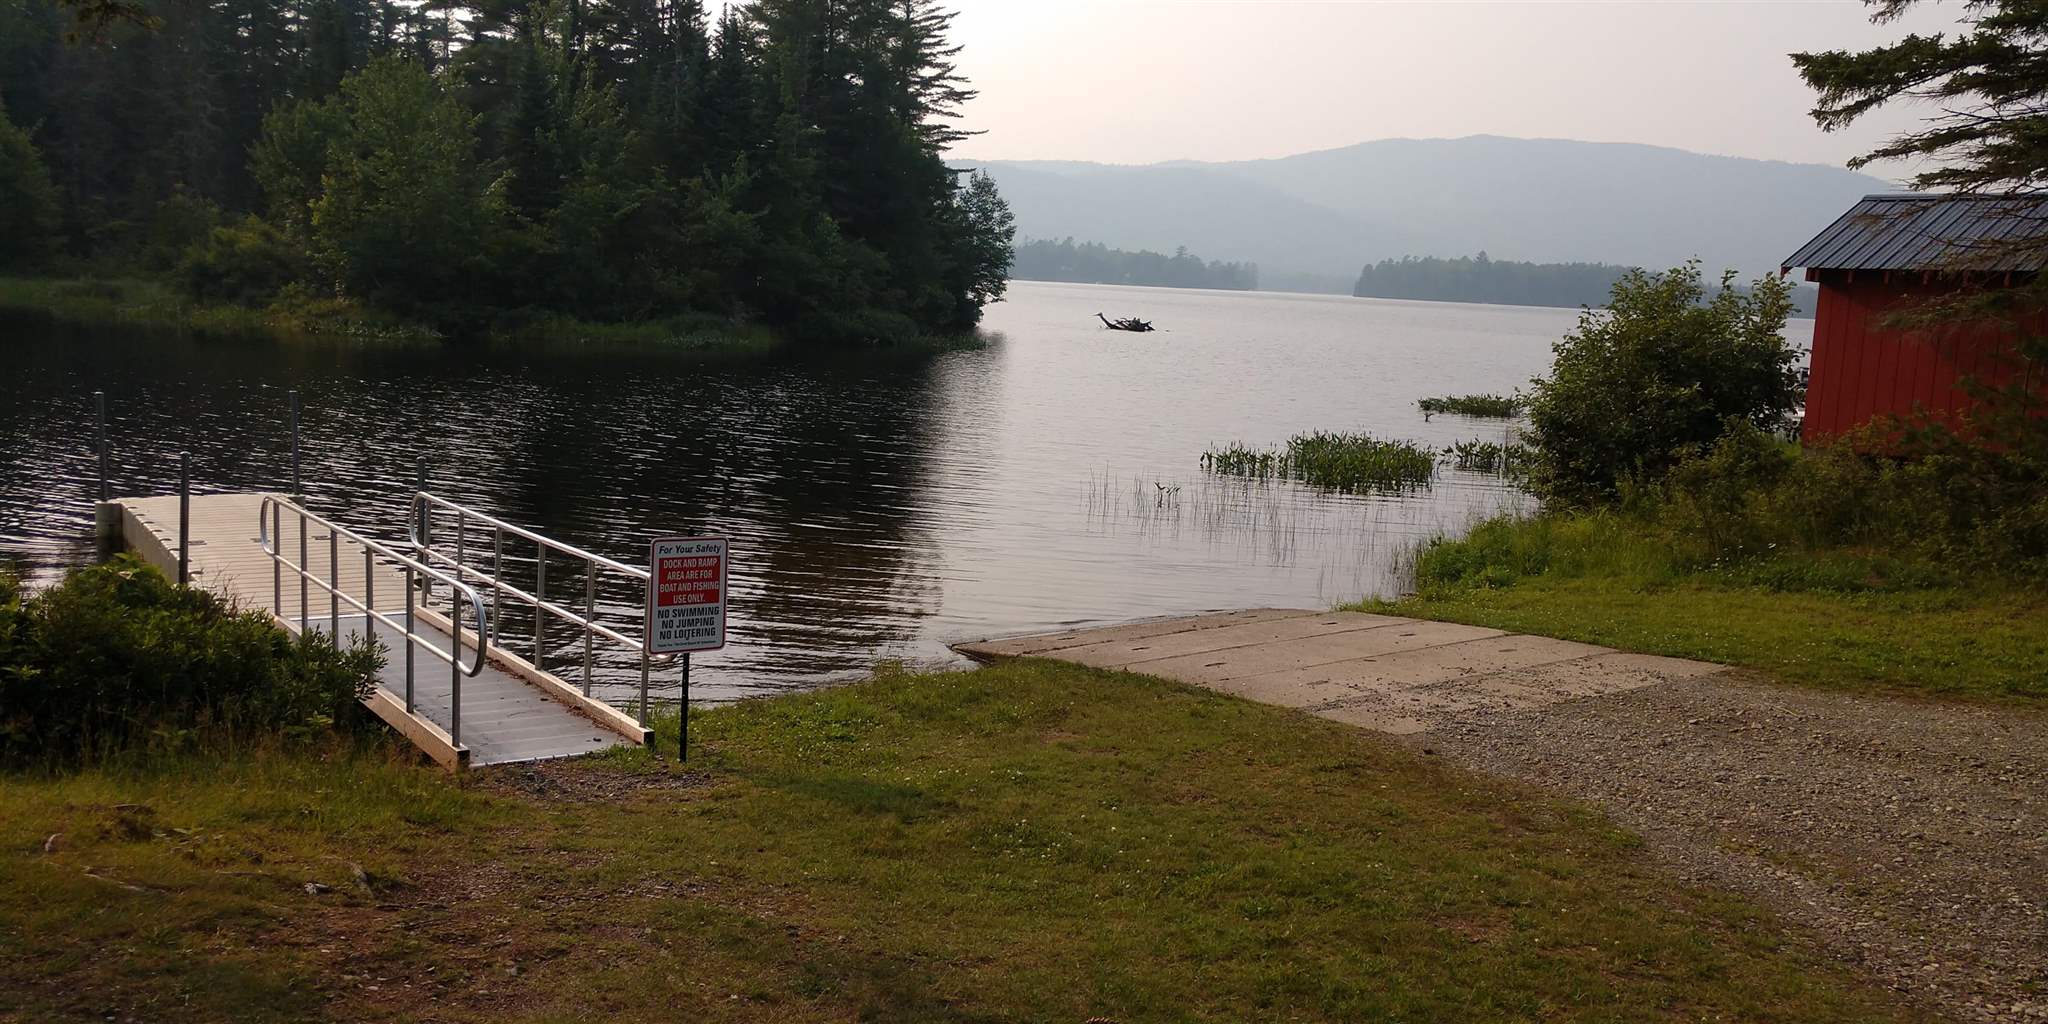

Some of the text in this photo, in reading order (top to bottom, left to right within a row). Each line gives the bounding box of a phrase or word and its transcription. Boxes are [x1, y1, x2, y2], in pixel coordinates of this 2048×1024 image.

[659, 544, 721, 554] For Your Safety
[663, 558, 717, 568] DOCK AND RAMP
[667, 570, 712, 580] AREA ARE FOR
[660, 581, 719, 592] BOAT AND FISHING
[673, 595, 687, 603] USE
[658, 607, 719, 618] NO SWIMMING
[662, 617, 714, 629] NO JUMPING
[660, 628, 715, 640] NO LOITERING
